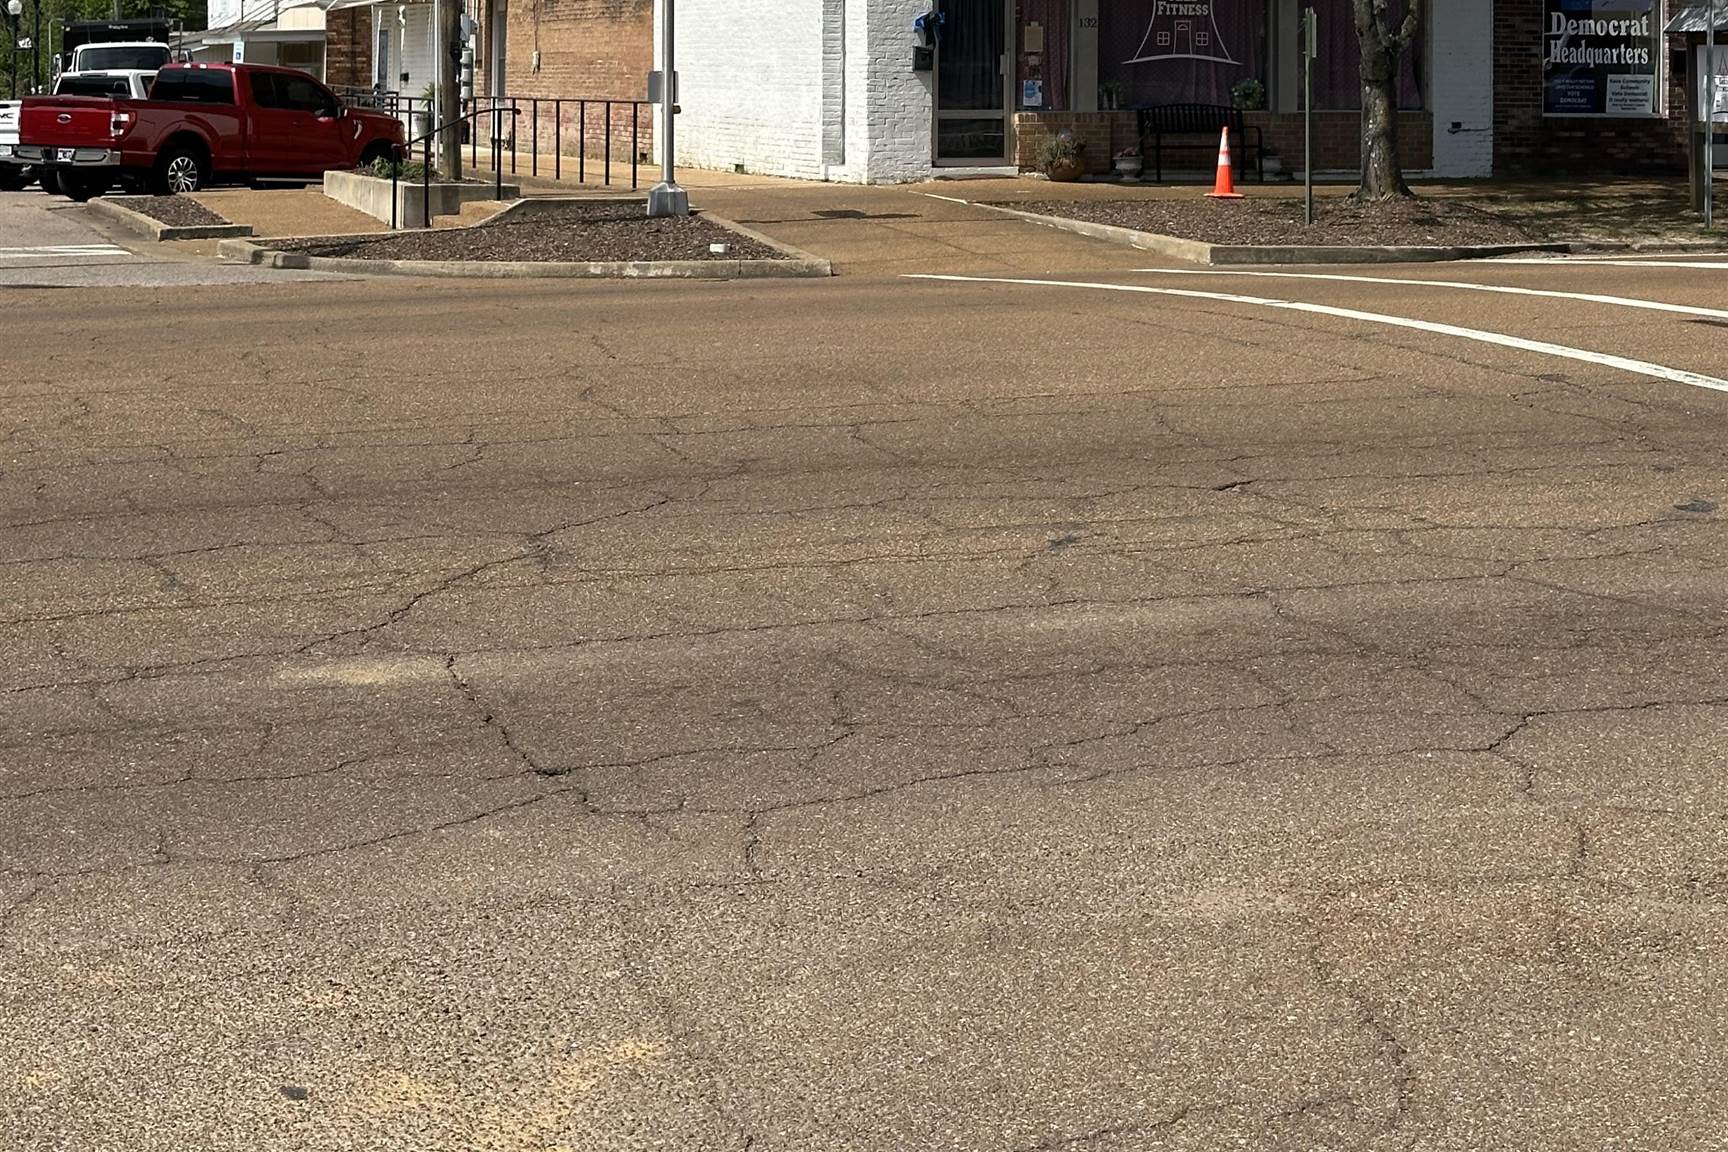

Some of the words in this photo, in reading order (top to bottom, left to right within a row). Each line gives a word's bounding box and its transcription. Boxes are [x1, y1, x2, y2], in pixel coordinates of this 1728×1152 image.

[1080, 17, 1097, 28] 132
[1550, 12, 1649, 36] Democrat
[1550, 39, 1649, 68] Headquarters
